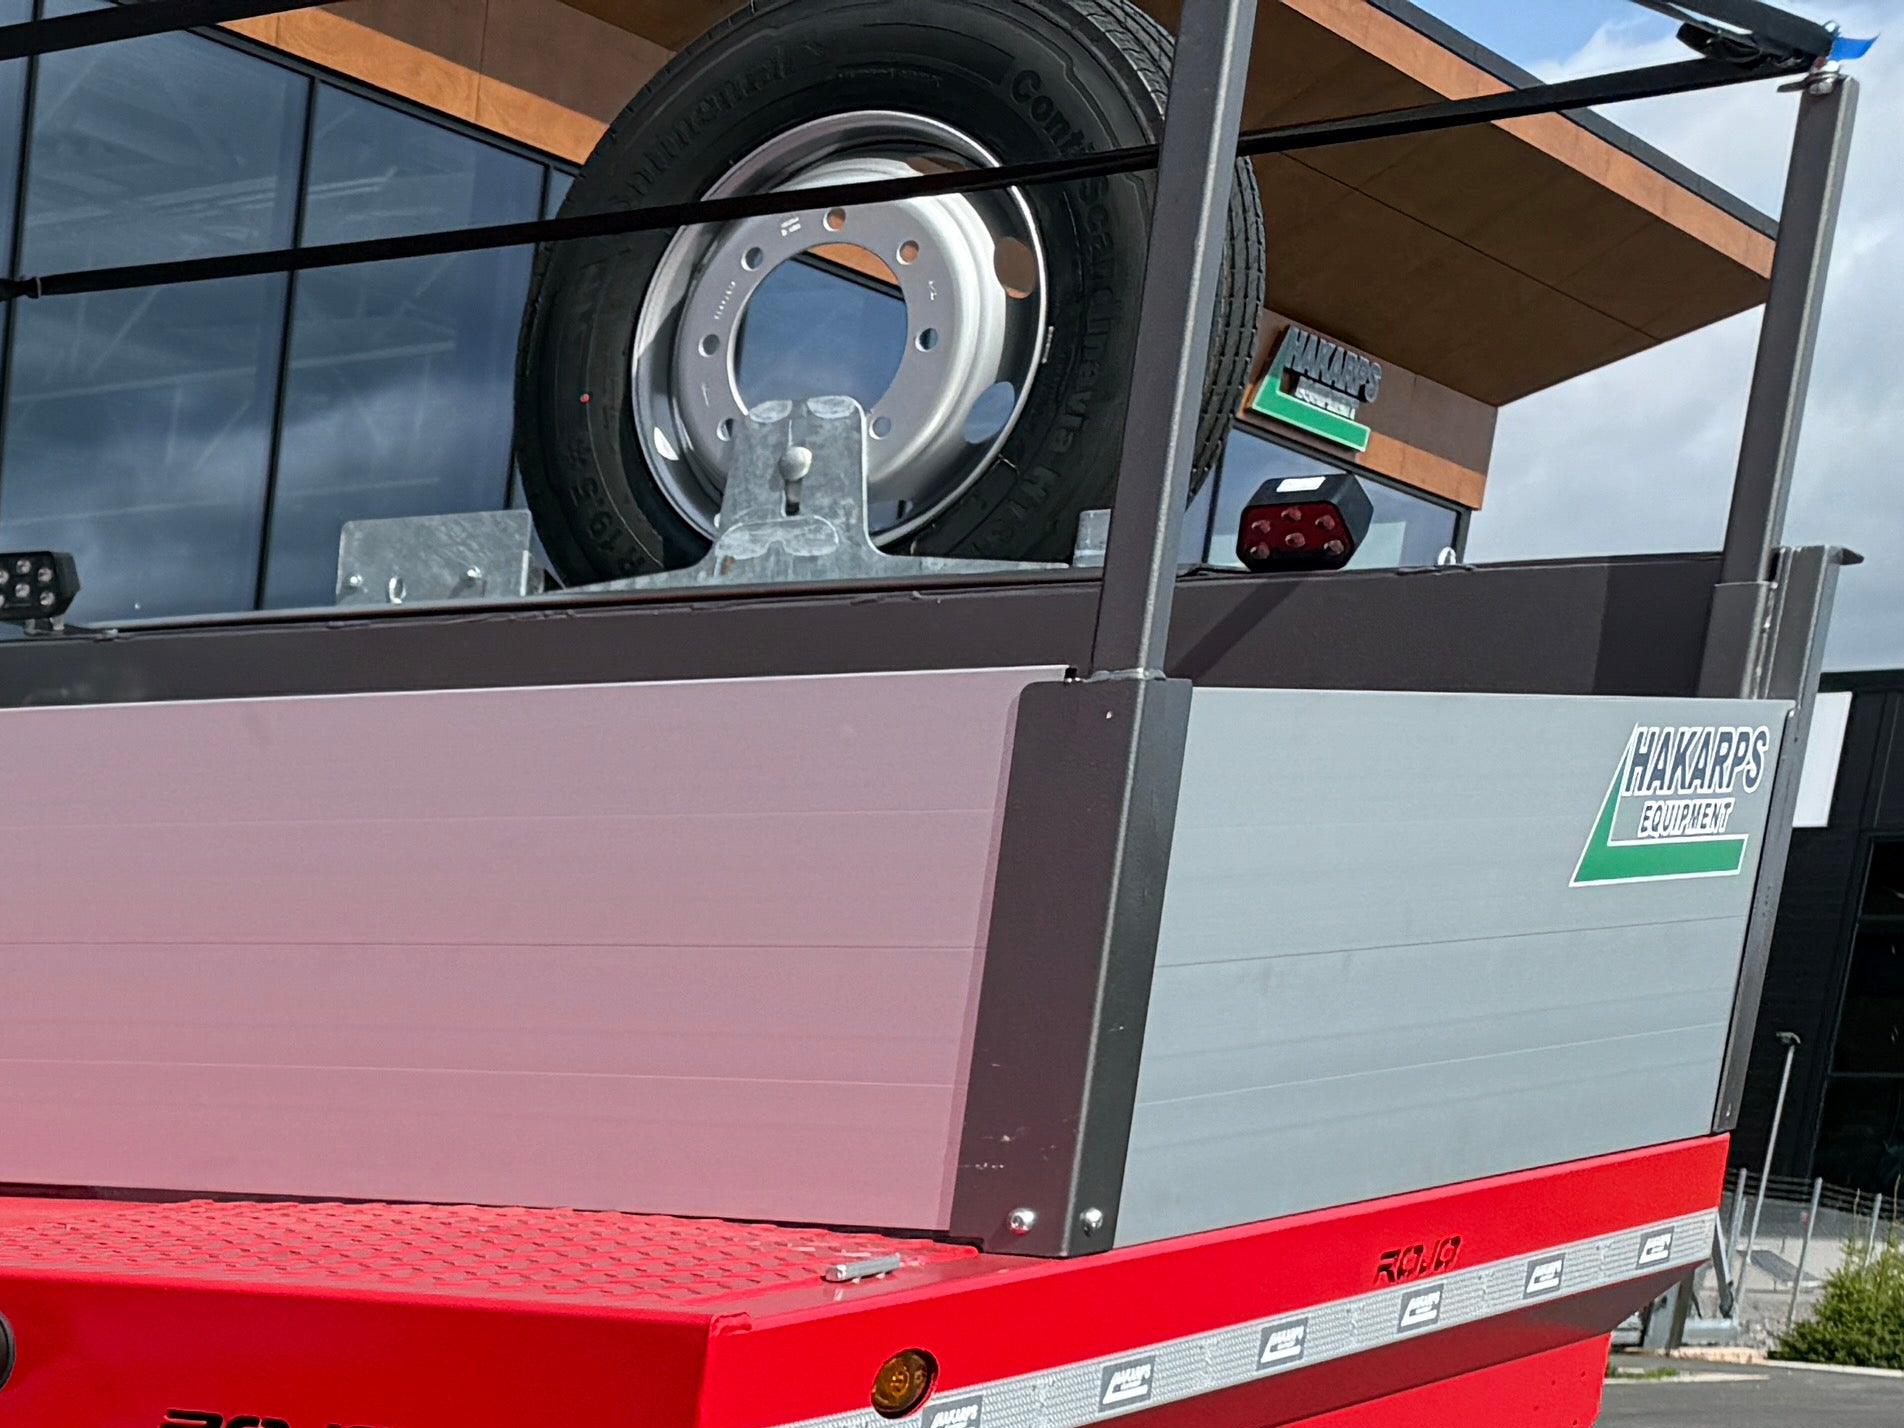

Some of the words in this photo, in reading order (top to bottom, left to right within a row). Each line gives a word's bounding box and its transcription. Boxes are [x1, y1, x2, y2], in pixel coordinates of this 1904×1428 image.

[1284, 325, 1382, 403] HAKARPS
[1623, 728, 1769, 793] HAKARPS
[1640, 801, 1733, 834] EQUIPMENT
[1374, 1235, 1461, 1284] ROJO
